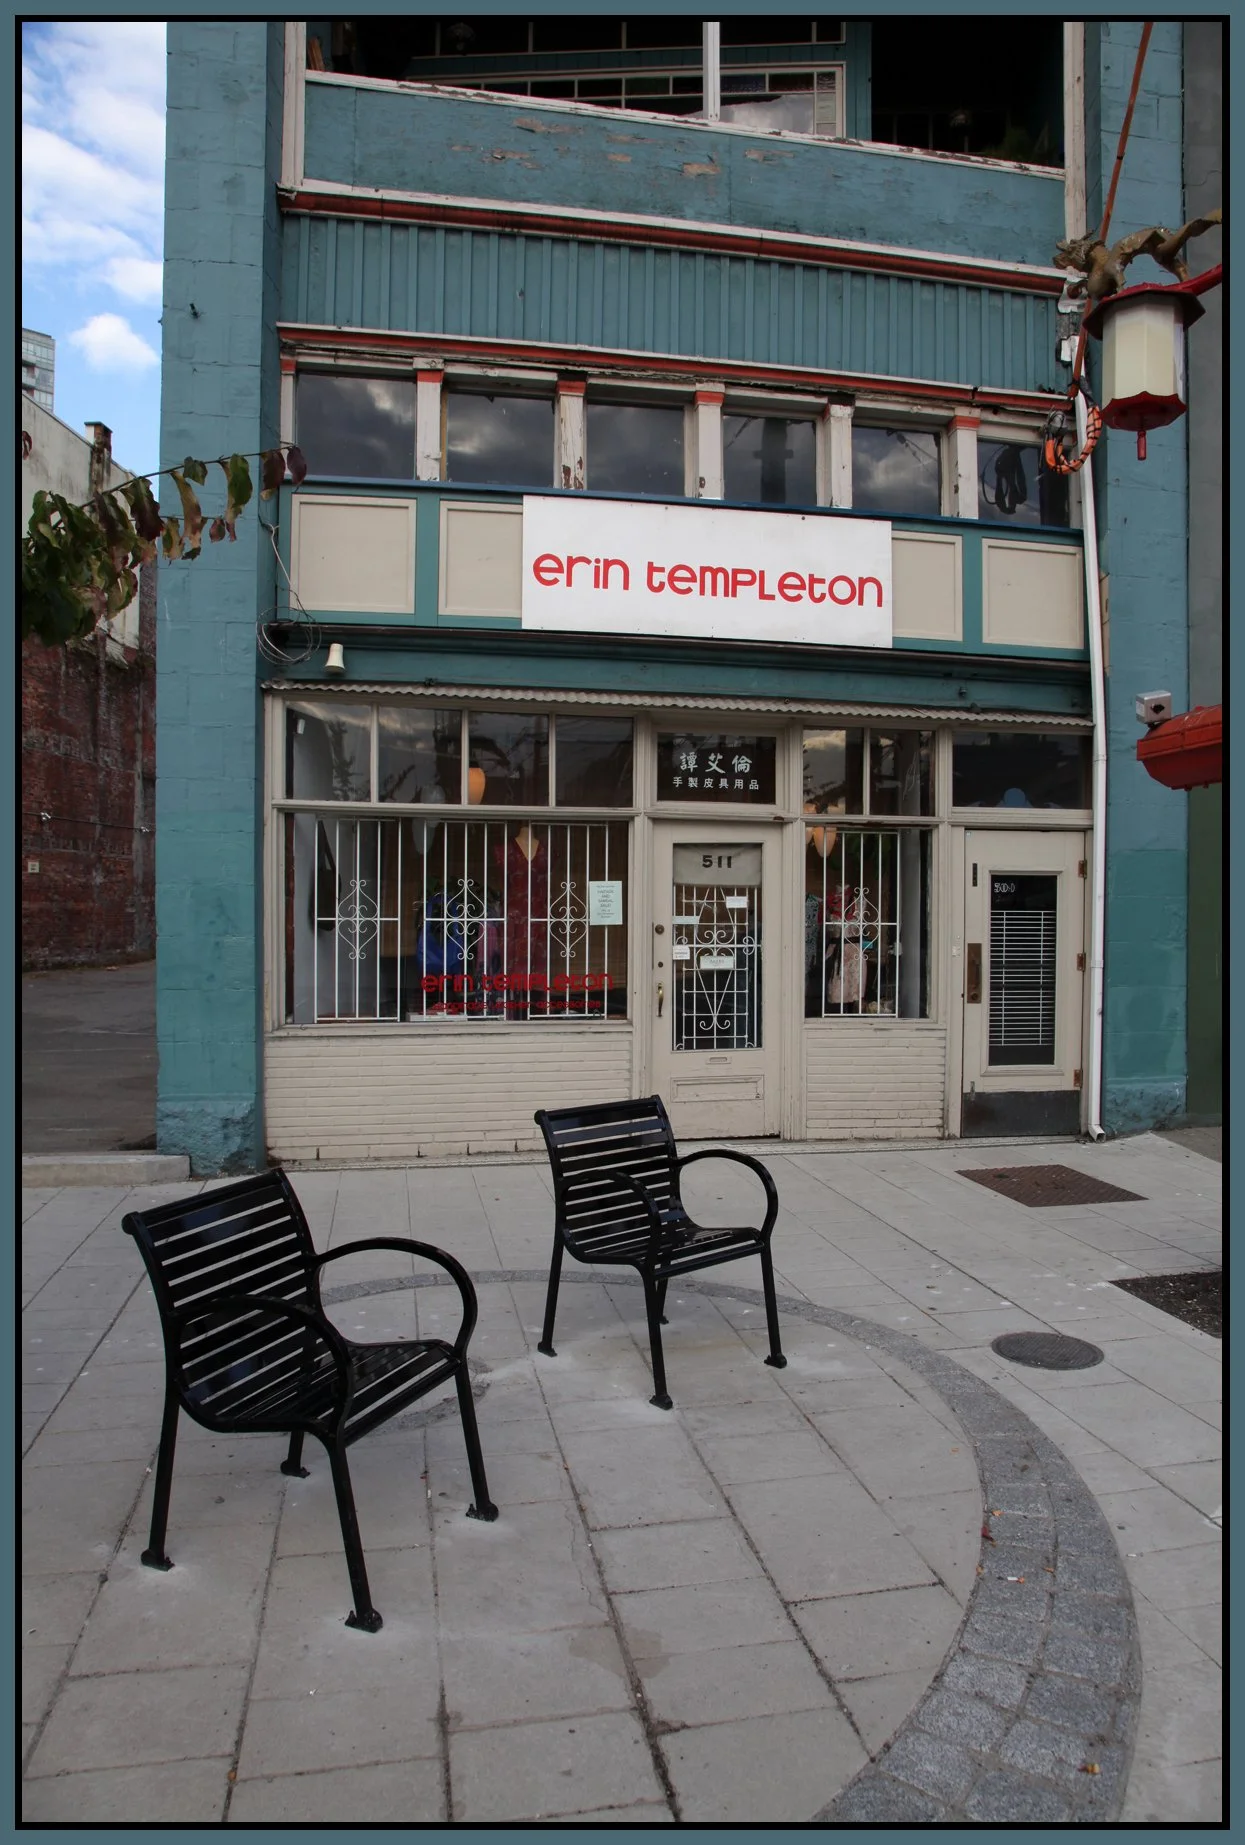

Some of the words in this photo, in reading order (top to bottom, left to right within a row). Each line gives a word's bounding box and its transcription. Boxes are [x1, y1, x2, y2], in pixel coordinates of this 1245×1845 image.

[532, 553, 630, 591] erin
[646, 561, 884, 608] templeton
[680, 752, 752, 774] 譚艾倫
[672, 777, 759, 790] 手製皮具用品
[702, 855, 732, 868] 511
[420, 973, 474, 992] erin
